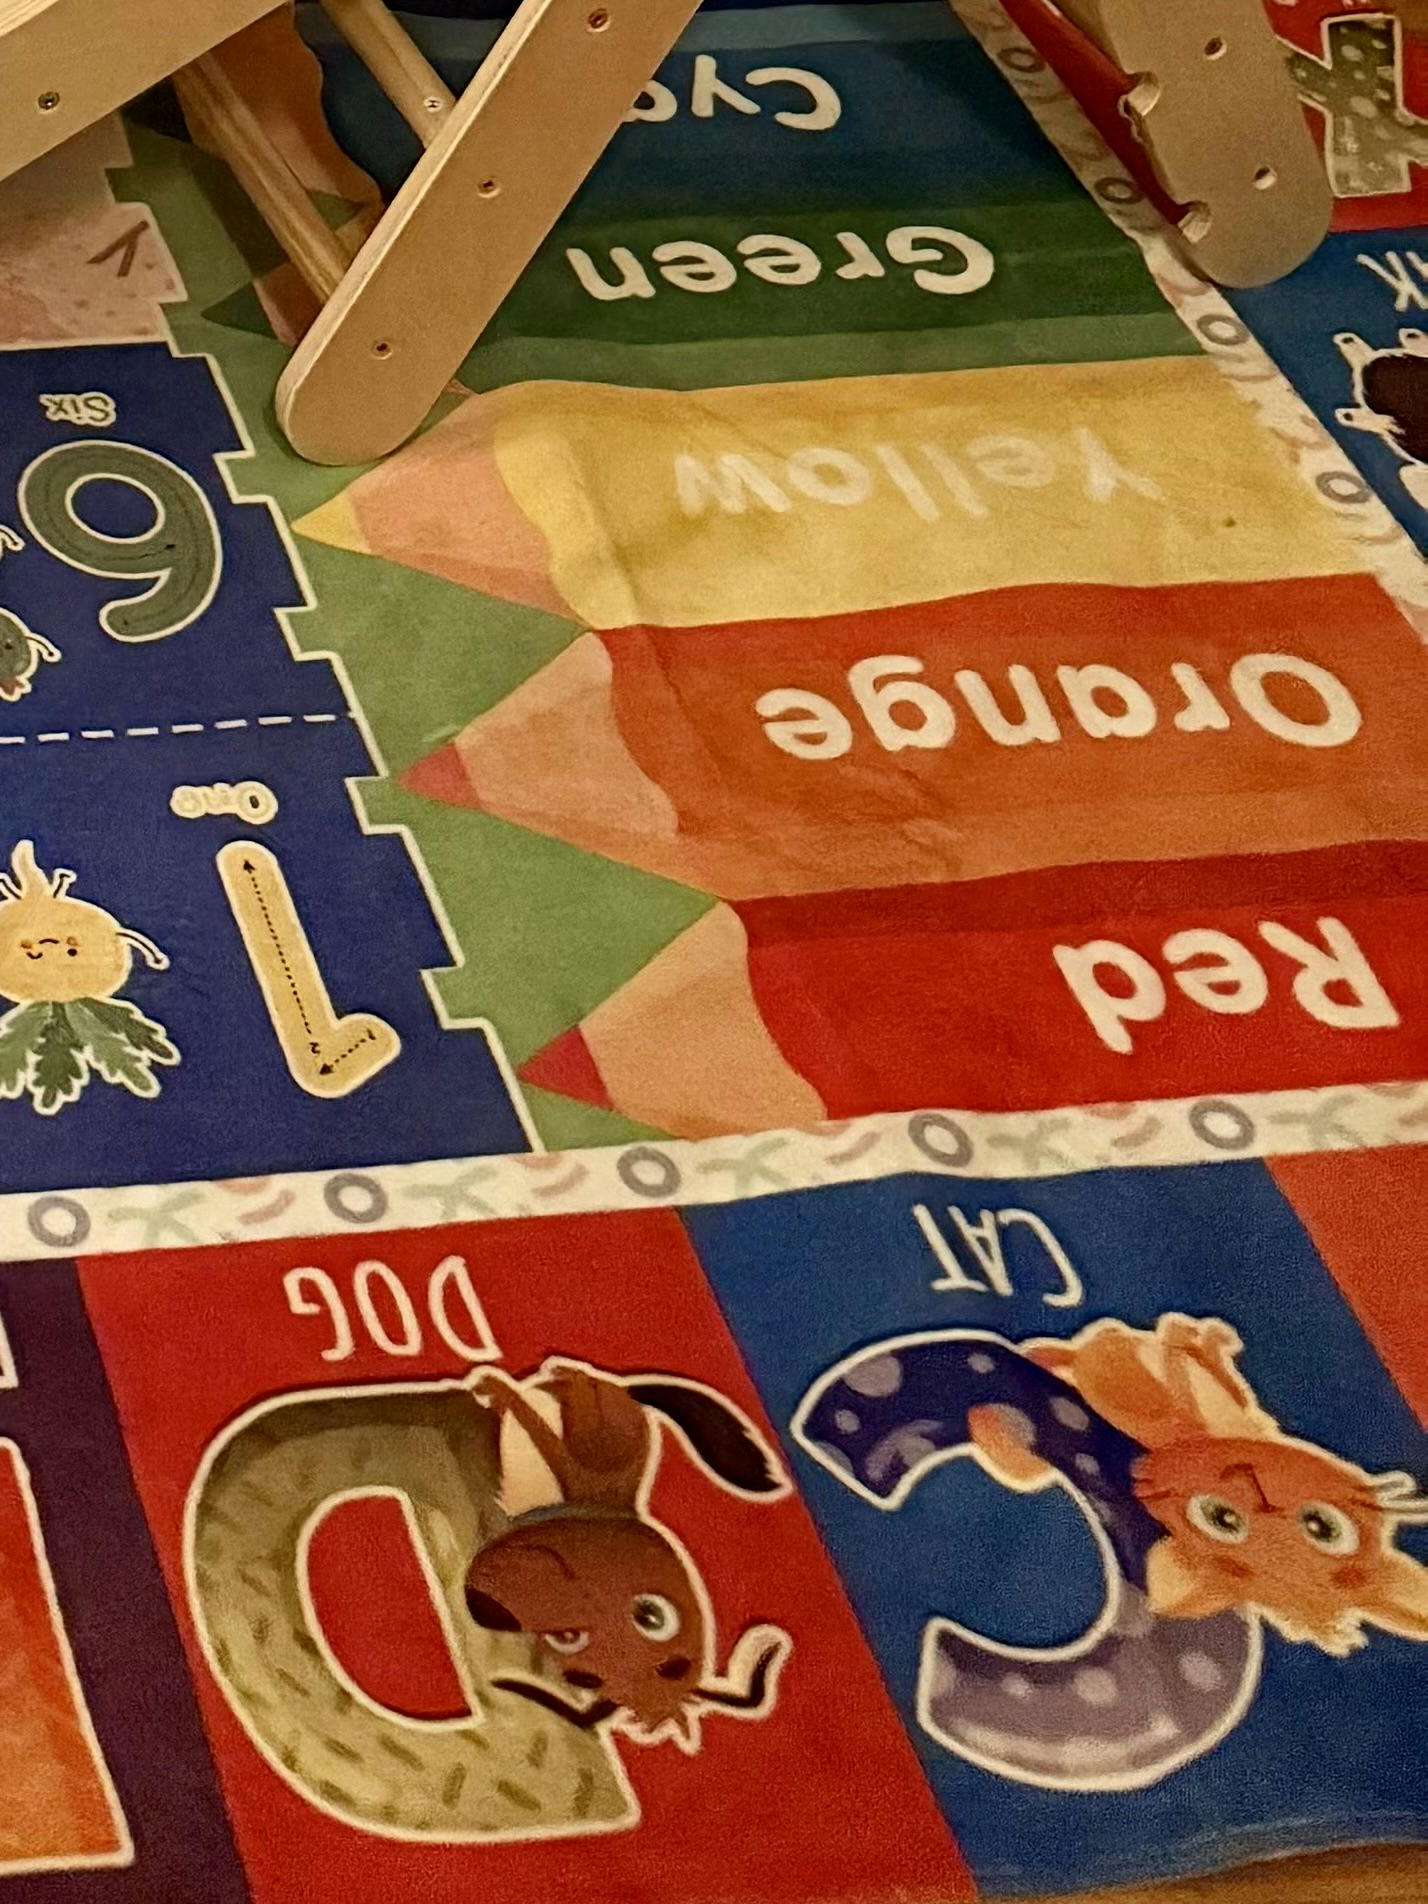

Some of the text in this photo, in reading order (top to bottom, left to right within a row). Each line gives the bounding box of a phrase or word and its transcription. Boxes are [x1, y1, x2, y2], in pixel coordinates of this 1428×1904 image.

[628, 54, 843, 131] Cya
[565, 222, 997, 302] Green
[38, 390, 117, 428] Six
[672, 426, 1162, 522] Yellow
[16, 439, 224, 644] 6
[752, 652, 1364, 761] Orange
[215, 839, 402, 1100] 1
[1051, 917, 1401, 1055] Red
[285, 1254, 506, 1364] DOG
[912, 1202, 1085, 1309] CAT
